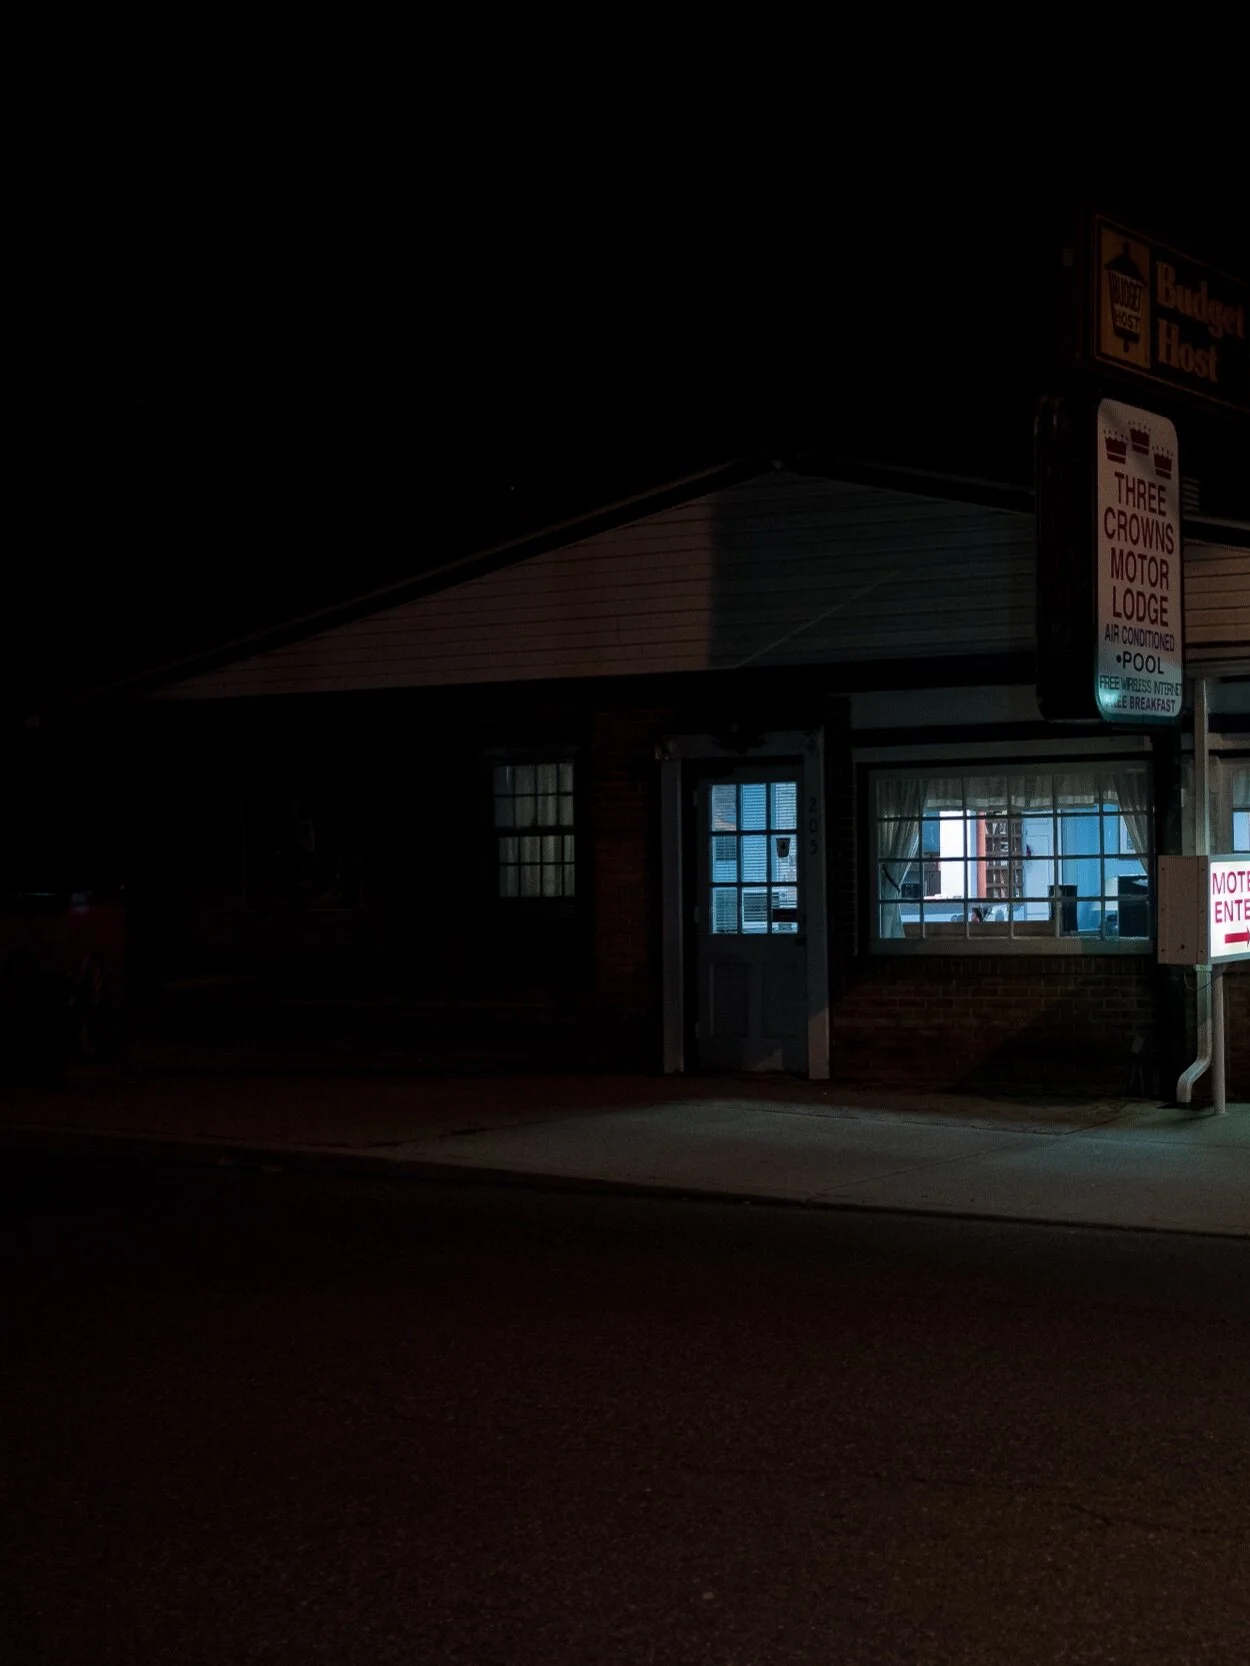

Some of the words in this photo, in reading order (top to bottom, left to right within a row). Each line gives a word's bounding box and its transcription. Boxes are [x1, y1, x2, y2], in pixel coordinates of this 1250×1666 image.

[1114, 309, 1141, 329] HOST
[1155, 260, 1246, 341] Budget
[1157, 318, 1218, 382] Host
[1115, 472, 1166, 516] THREE
[1105, 508, 1174, 554] CROWNS
[1111, 547, 1168, 590] MOTOR
[1113, 586, 1168, 626] LODGE
[1105, 623, 1119, 643] AIR
[1122, 627, 1174, 652] CONDITIONED
[1100, 675, 1120, 690] FREE
[1121, 677, 1151, 693] WIRELESS
[1130, 696, 1175, 712] BREAKFAST
